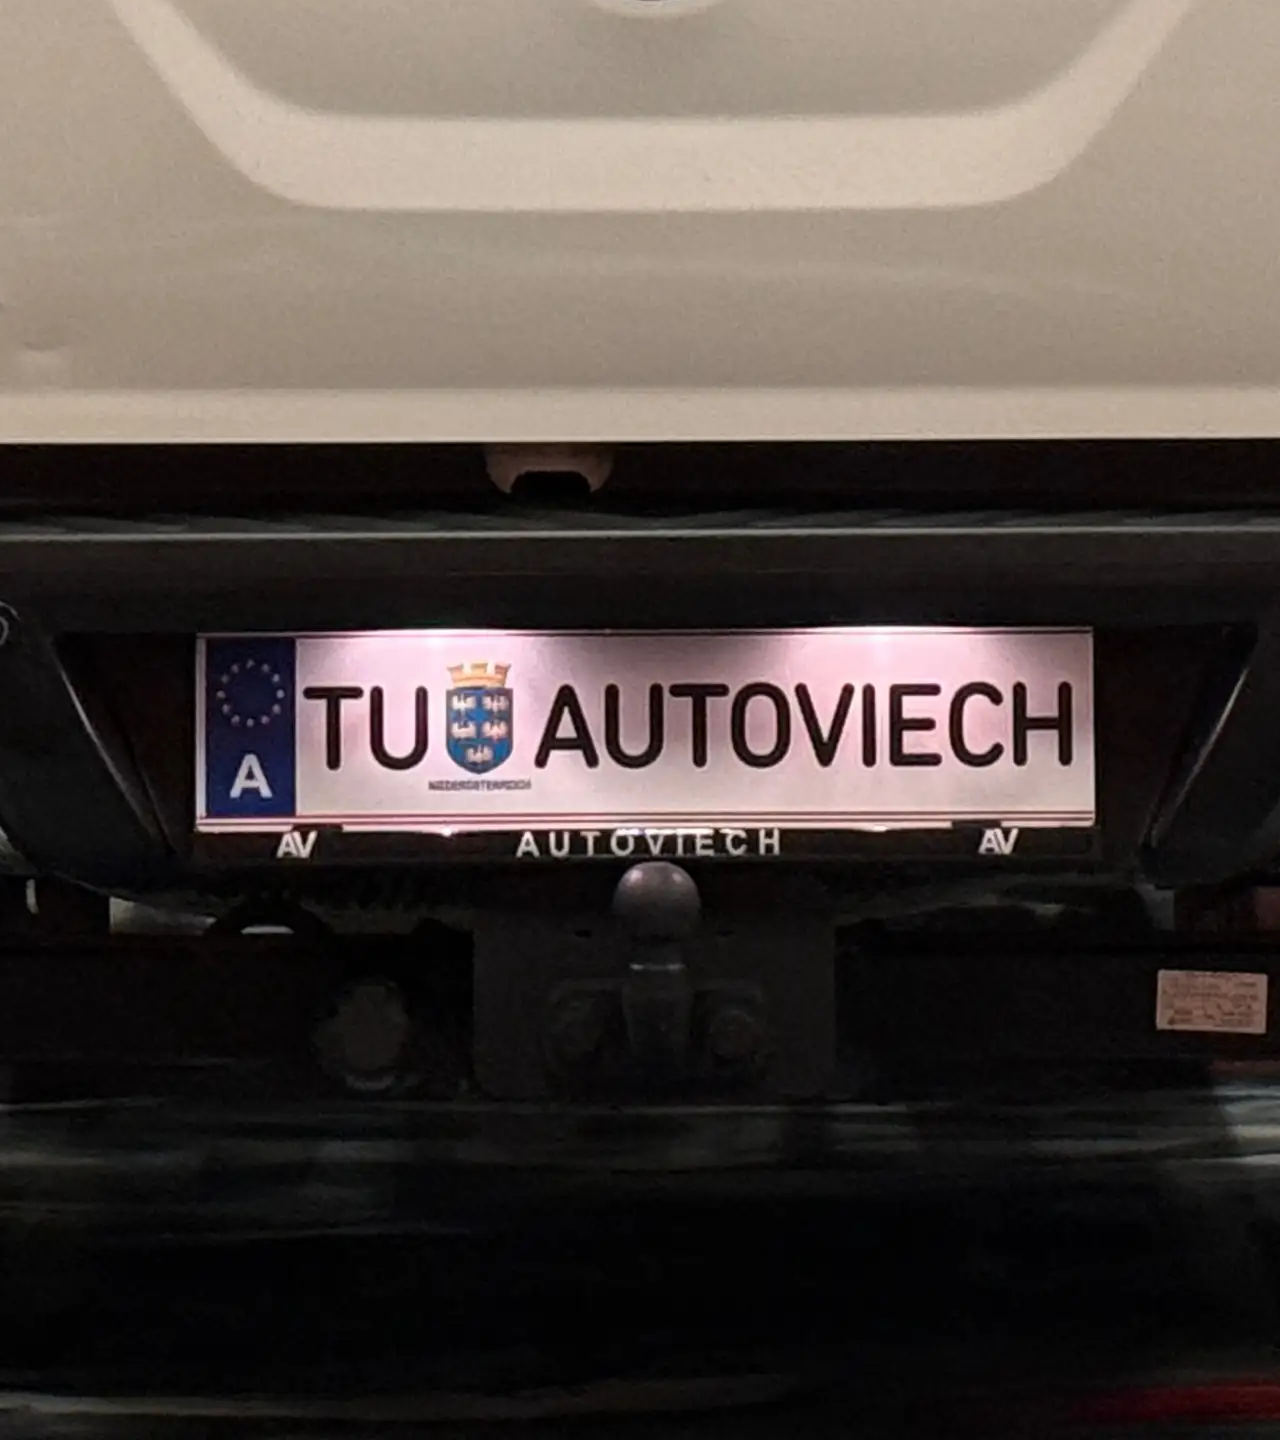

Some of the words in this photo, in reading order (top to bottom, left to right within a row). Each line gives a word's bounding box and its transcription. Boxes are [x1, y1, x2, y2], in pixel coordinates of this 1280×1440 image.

[303, 686, 429, 770] TU
[534, 681, 1073, 768] AUTOVIECH
[230, 754, 273, 798] A
[276, 830, 317, 858] AV
[516, 828, 780, 857] AUTOVIECH
[978, 828, 1019, 855] AV
